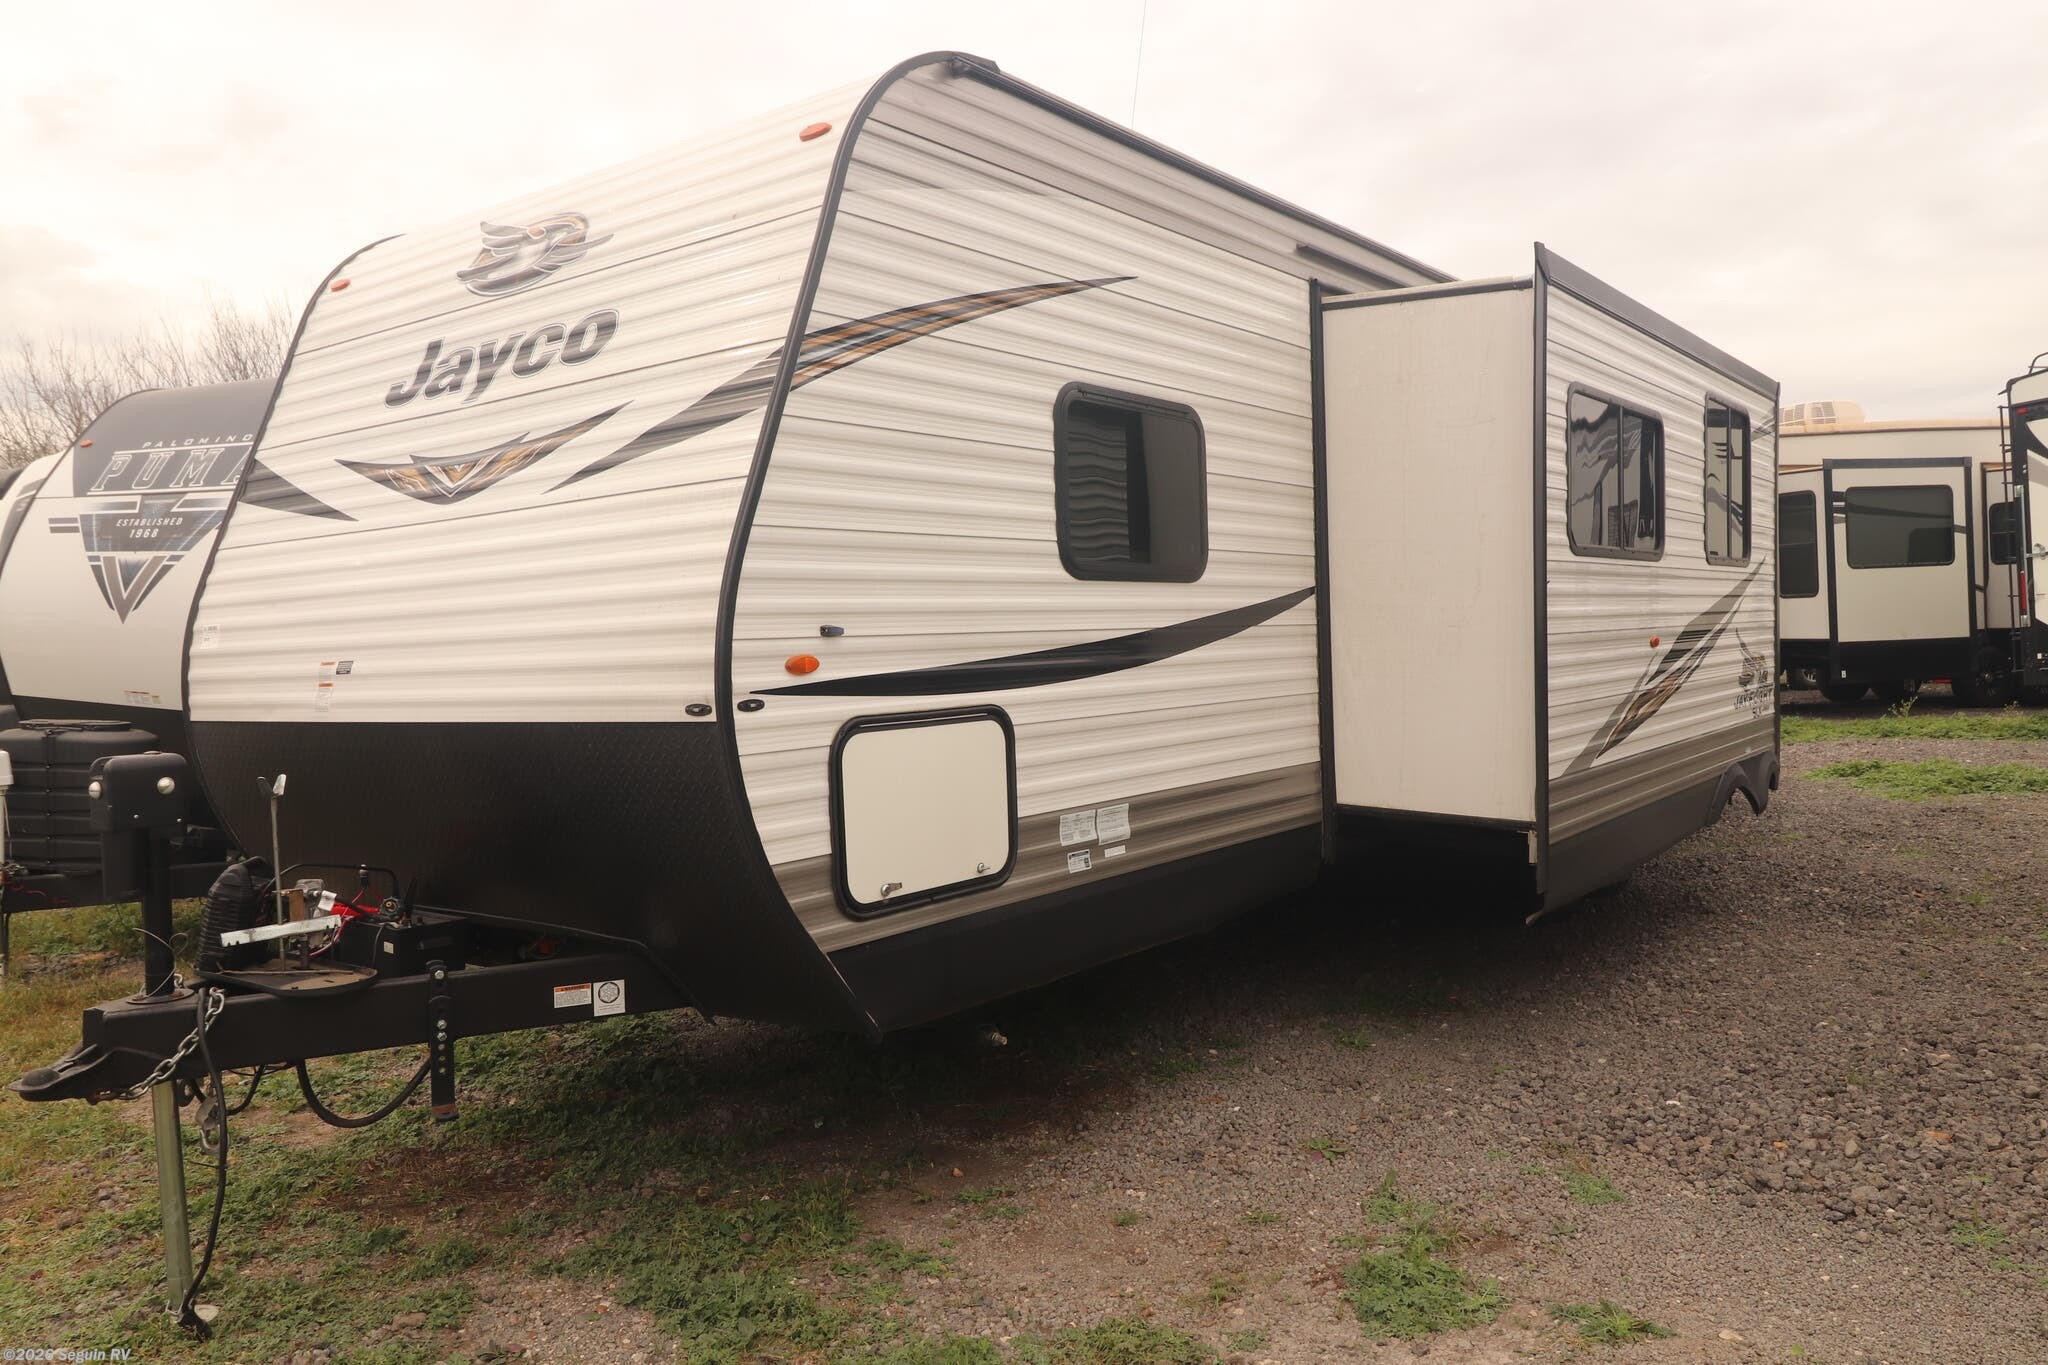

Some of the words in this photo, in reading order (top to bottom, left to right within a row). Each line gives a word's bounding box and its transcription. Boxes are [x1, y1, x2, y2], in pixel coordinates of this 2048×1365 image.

[384, 308, 619, 408] Jayco
[142, 434, 254, 449] PALOMINO
[116, 517, 183, 527] ESTABLISHED
[129, 528, 159, 538] 1968
